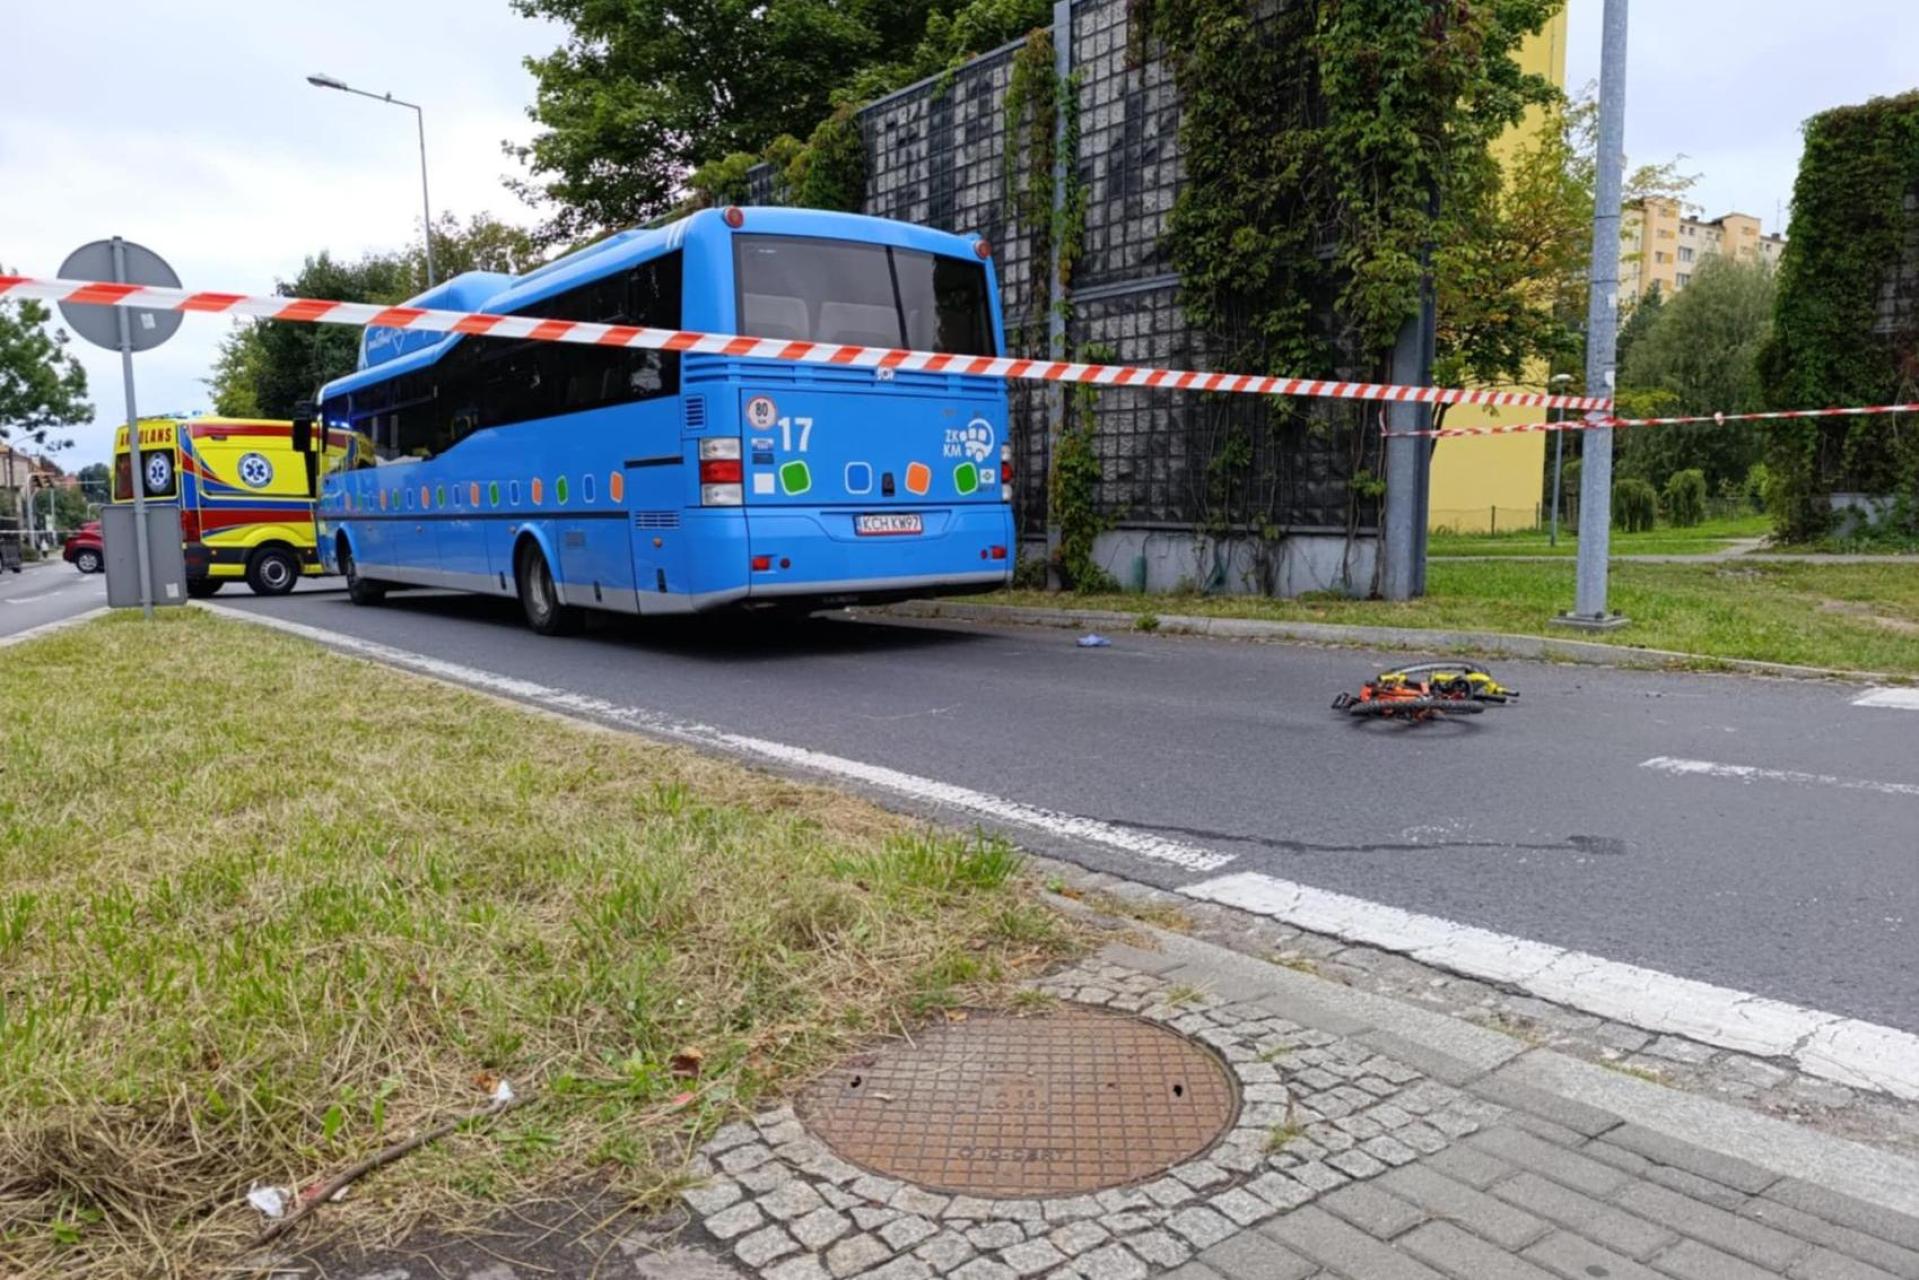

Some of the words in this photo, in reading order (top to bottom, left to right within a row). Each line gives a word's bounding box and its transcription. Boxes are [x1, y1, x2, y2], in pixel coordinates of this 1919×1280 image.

[755, 401, 769, 417] 80
[778, 416, 813, 451] 17
[943, 443, 962, 457] KM
[863, 515, 889, 529] KCH
